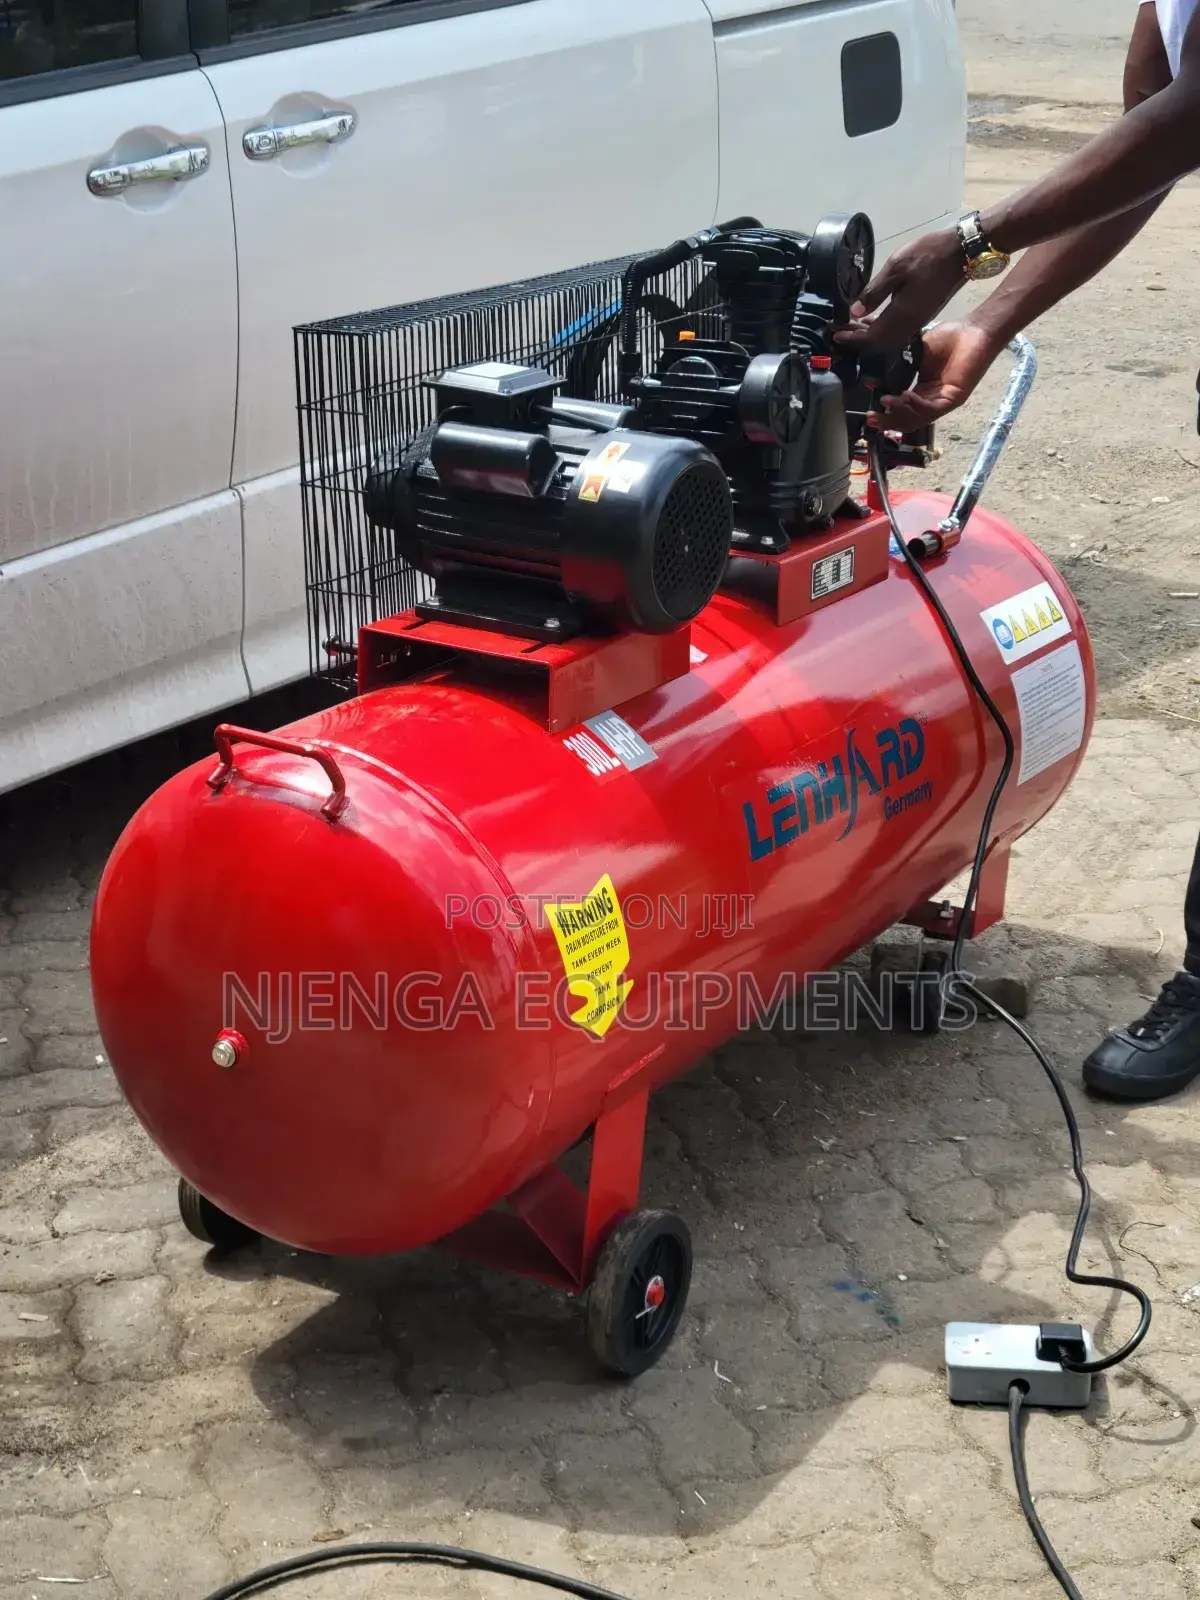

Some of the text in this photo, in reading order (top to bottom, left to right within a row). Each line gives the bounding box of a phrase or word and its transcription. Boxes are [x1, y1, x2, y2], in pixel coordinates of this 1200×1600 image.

[562, 717, 645, 777] 300L 4HP
[883, 779, 933, 821] Germany
[554, 886, 614, 938] WARNING
[565, 917, 620, 955] DRAIN MOISTURE FROM
[571, 936, 622, 970] TANK EVERY WEEK
[586, 960, 613, 982] PREVENT
[594, 981, 611, 997] TANK
[586, 994, 621, 1023] CORROSION
